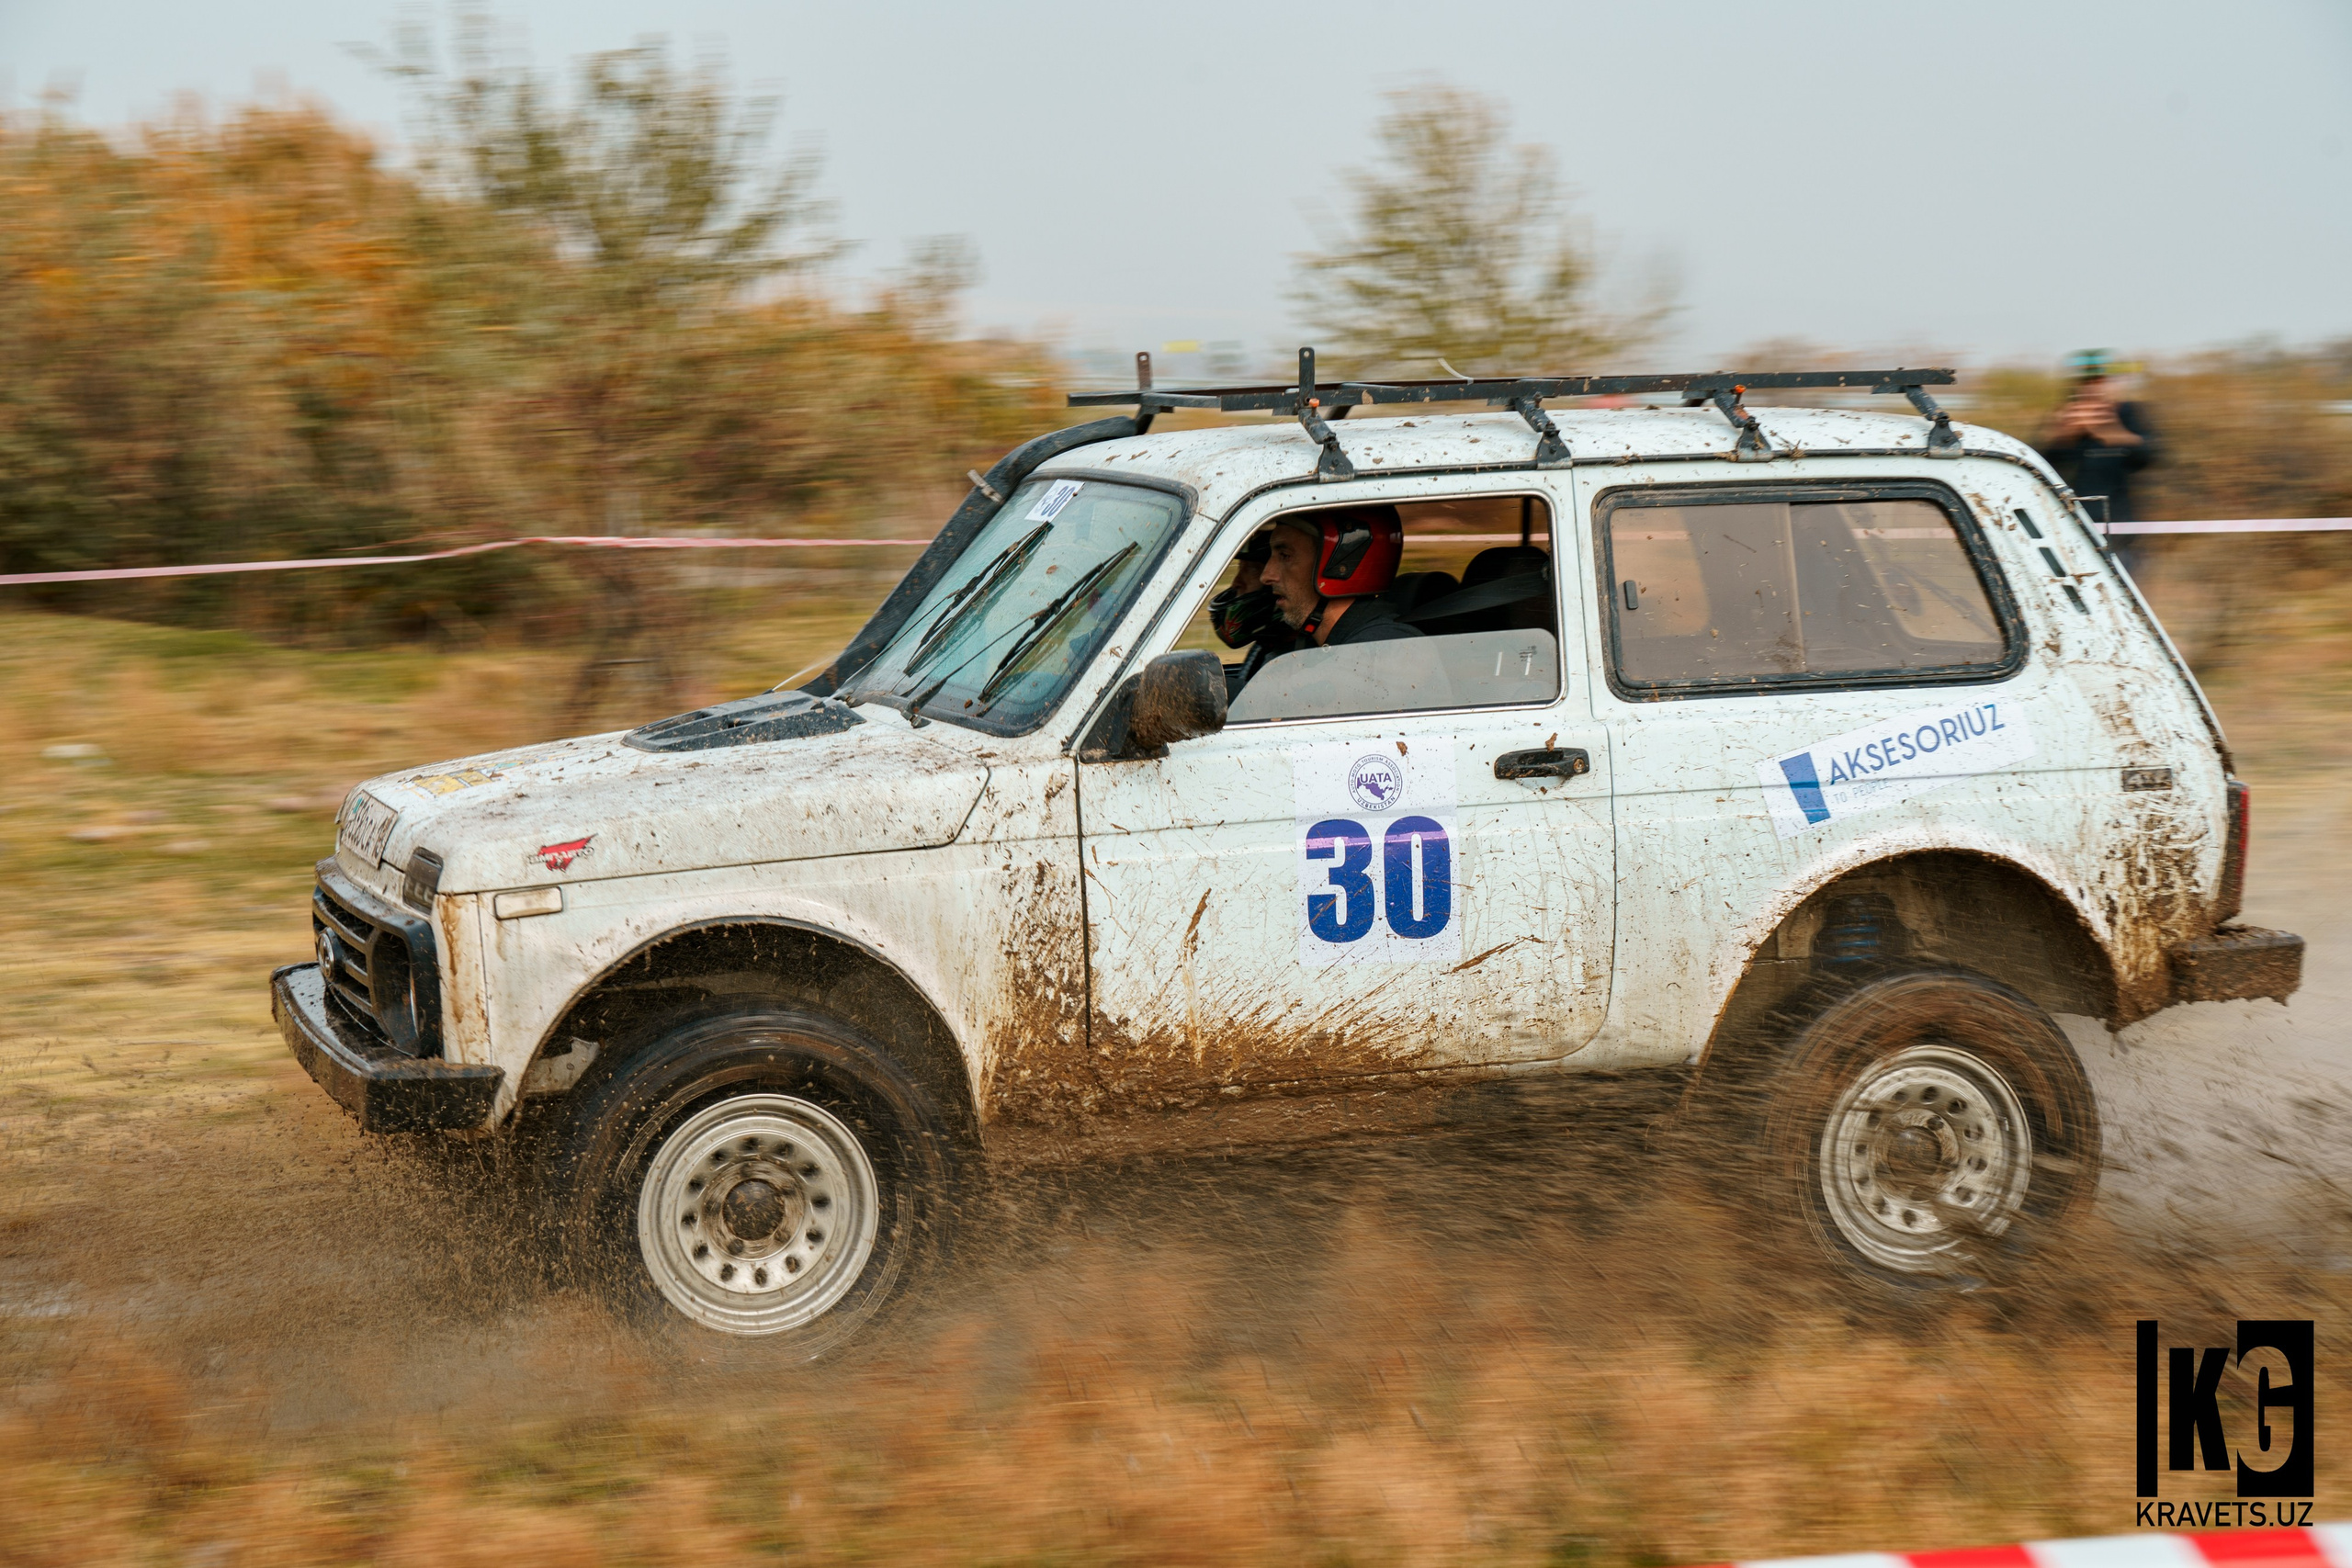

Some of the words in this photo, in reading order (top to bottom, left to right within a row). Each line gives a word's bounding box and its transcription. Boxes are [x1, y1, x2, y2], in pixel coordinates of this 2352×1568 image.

[1040, 485, 1076, 517] 30
[1829, 703, 2005, 785] AKSESORIUZ
[1360, 773, 1392, 784] UATA
[1361, 756, 1384, 764] TOURISM
[1385, 760, 1401, 792] ASSOCIATION
[1357, 796, 1396, 809] UZBEKISTAN
[1306, 815, 1451, 943] 30
